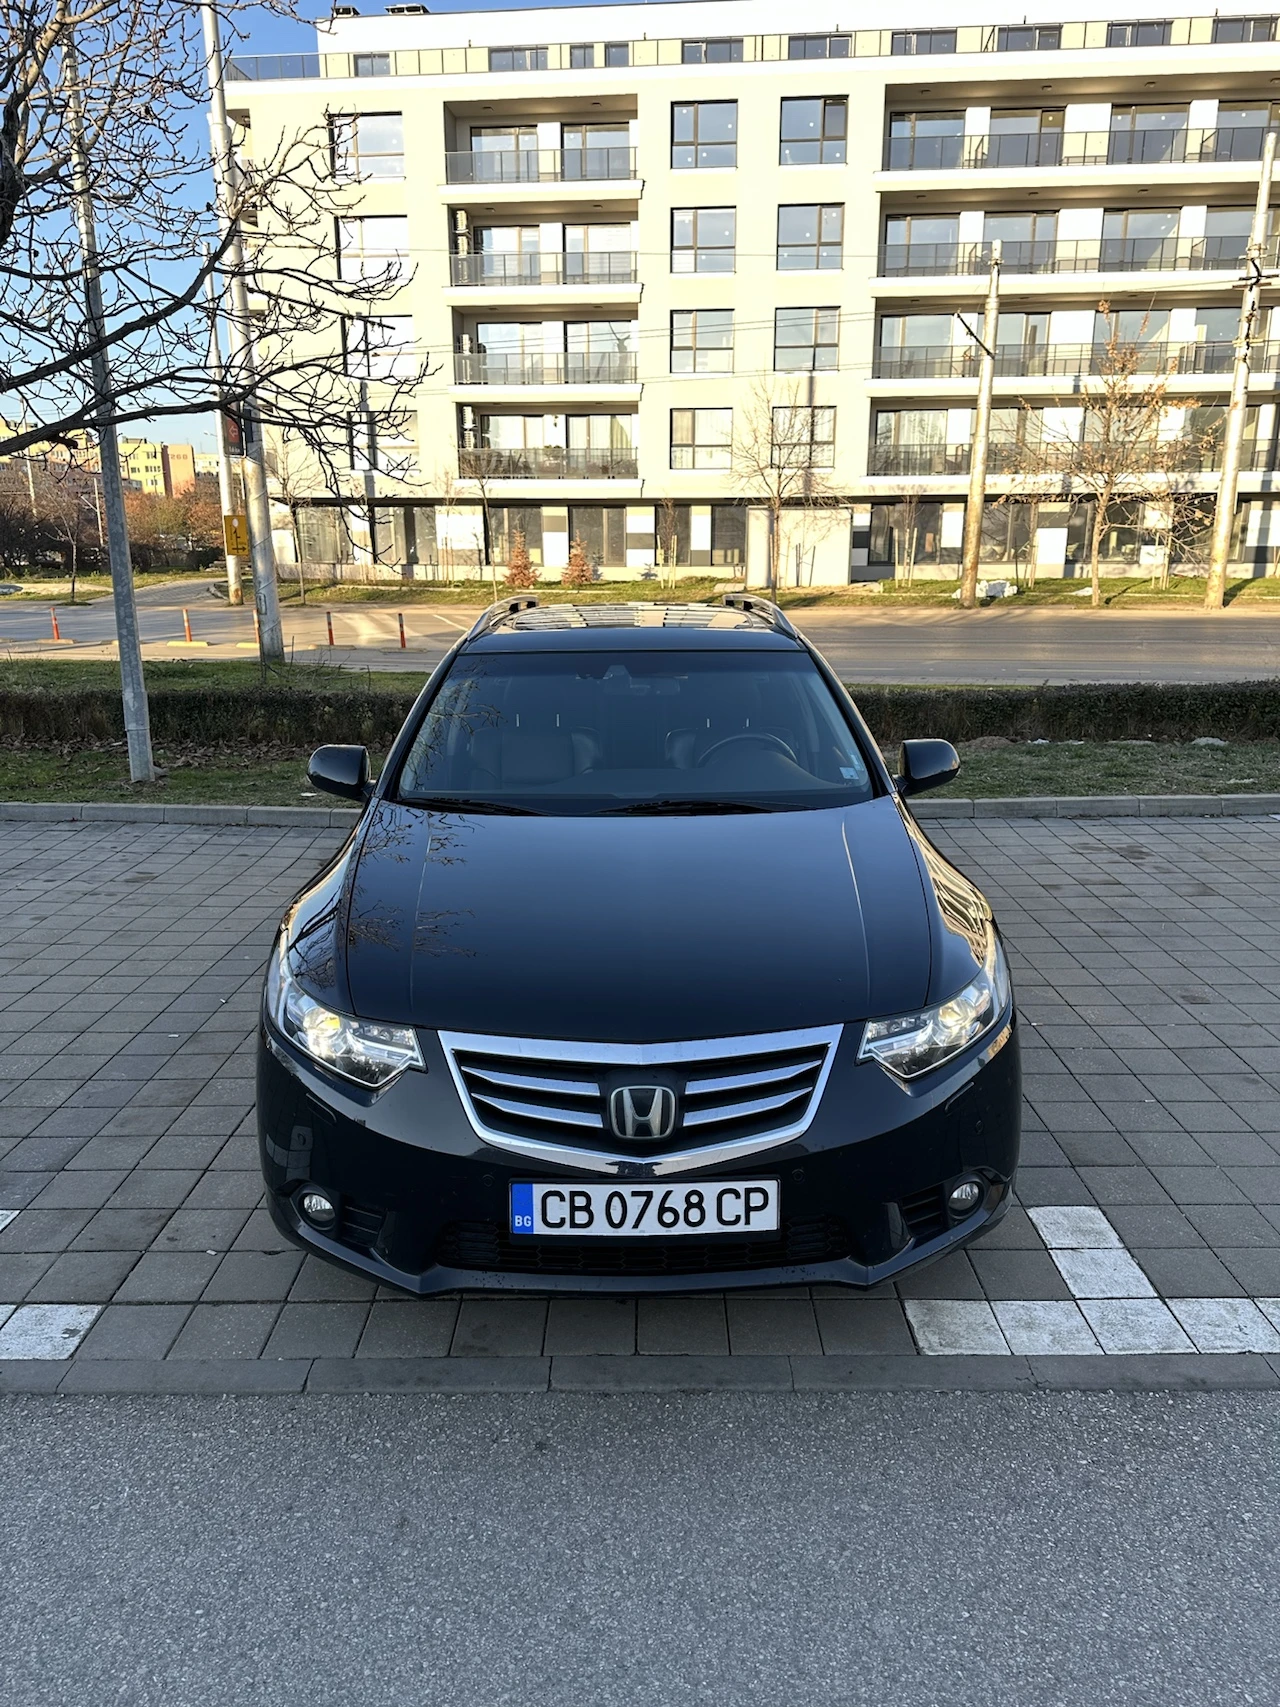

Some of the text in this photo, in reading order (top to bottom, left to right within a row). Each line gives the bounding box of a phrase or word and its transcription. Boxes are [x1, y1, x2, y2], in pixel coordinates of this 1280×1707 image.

[514, 1215, 532, 1227] BG
[541, 1187, 769, 1229] CB 0768 CP
